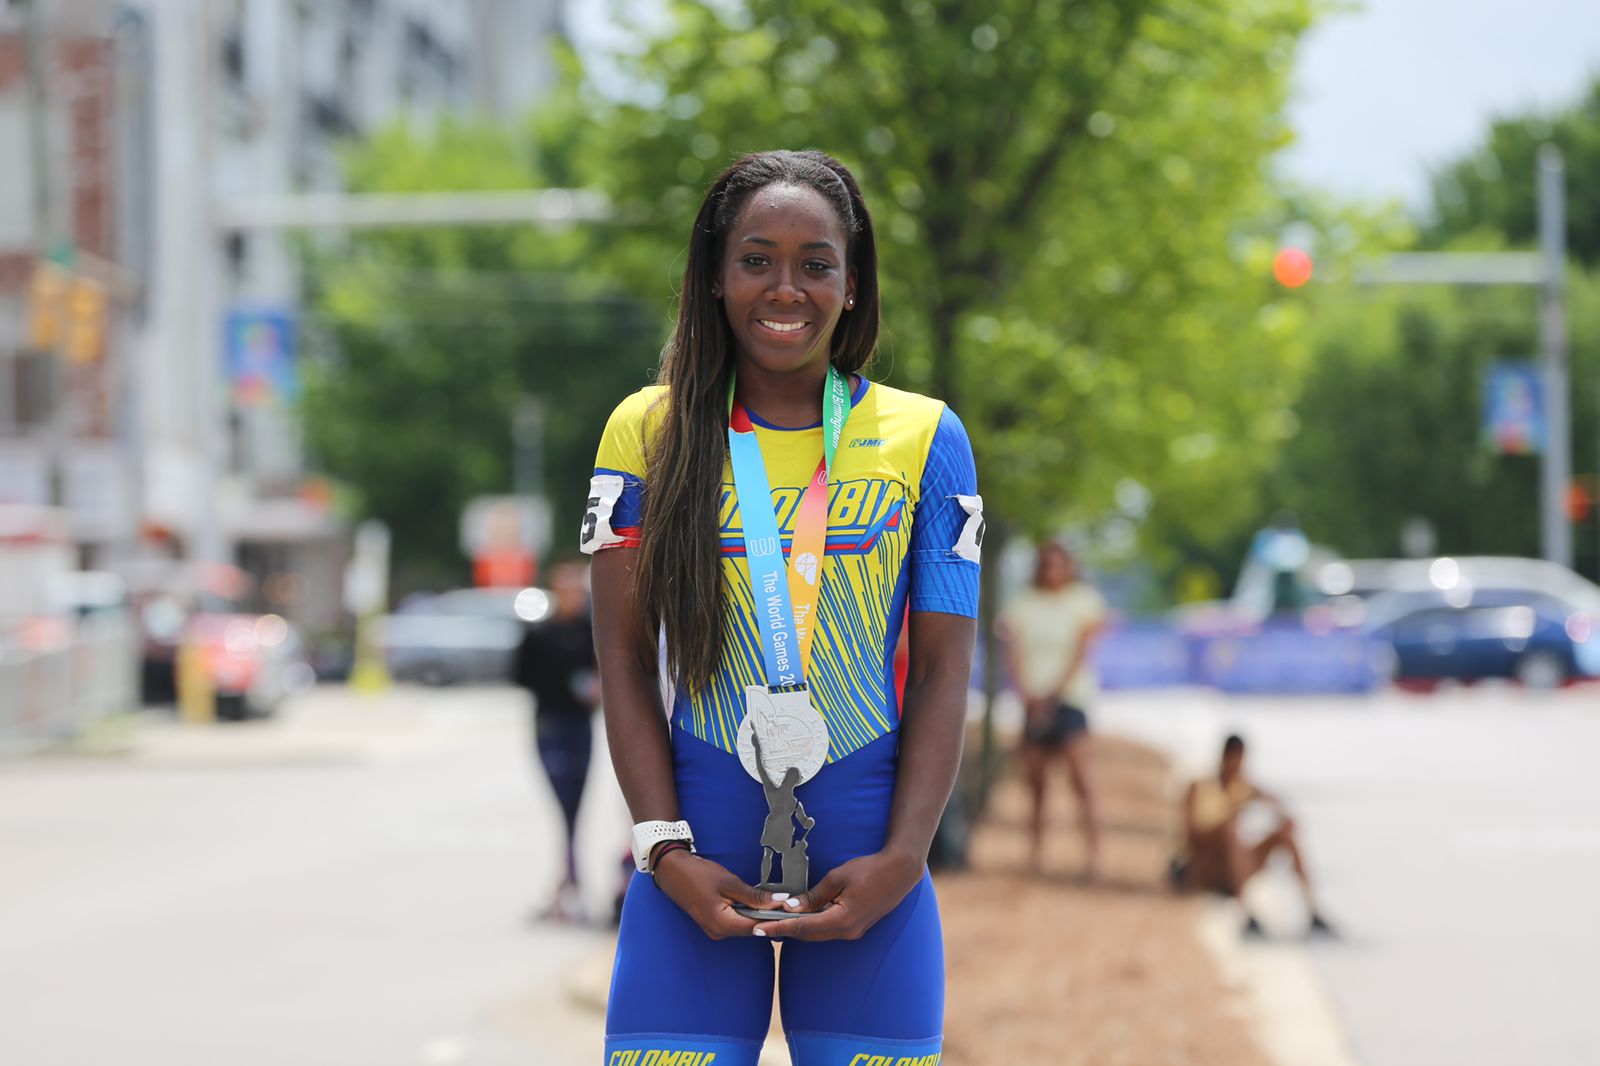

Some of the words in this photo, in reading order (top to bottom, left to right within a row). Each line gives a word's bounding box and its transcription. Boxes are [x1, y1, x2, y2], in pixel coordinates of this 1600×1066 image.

[762, 570, 778, 593] The
[766, 594, 786, 630] World
[793, 603, 810, 625] The
[773, 631, 789, 672] Games
